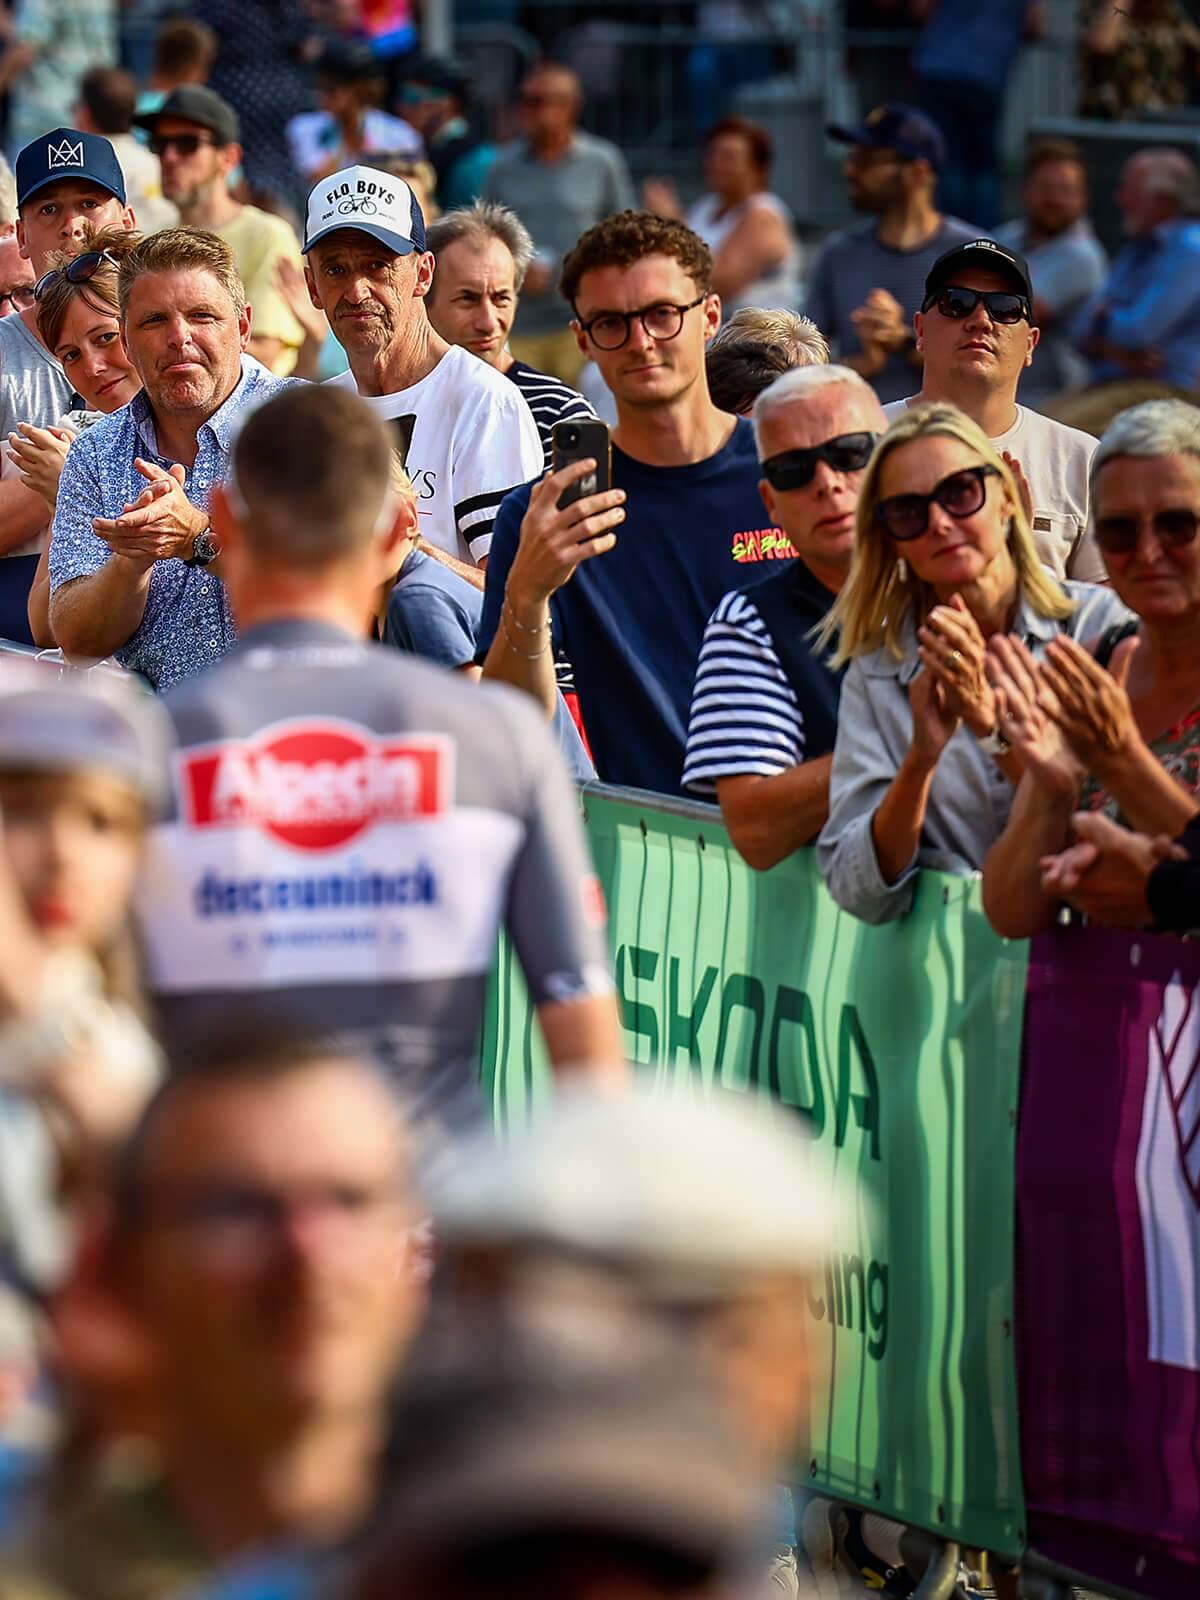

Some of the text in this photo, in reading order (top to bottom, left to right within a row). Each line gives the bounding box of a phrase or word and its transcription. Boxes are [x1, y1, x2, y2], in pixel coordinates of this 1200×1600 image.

[326, 180, 395, 205] FLO BOYS
[209, 740, 422, 824] Alpecin
